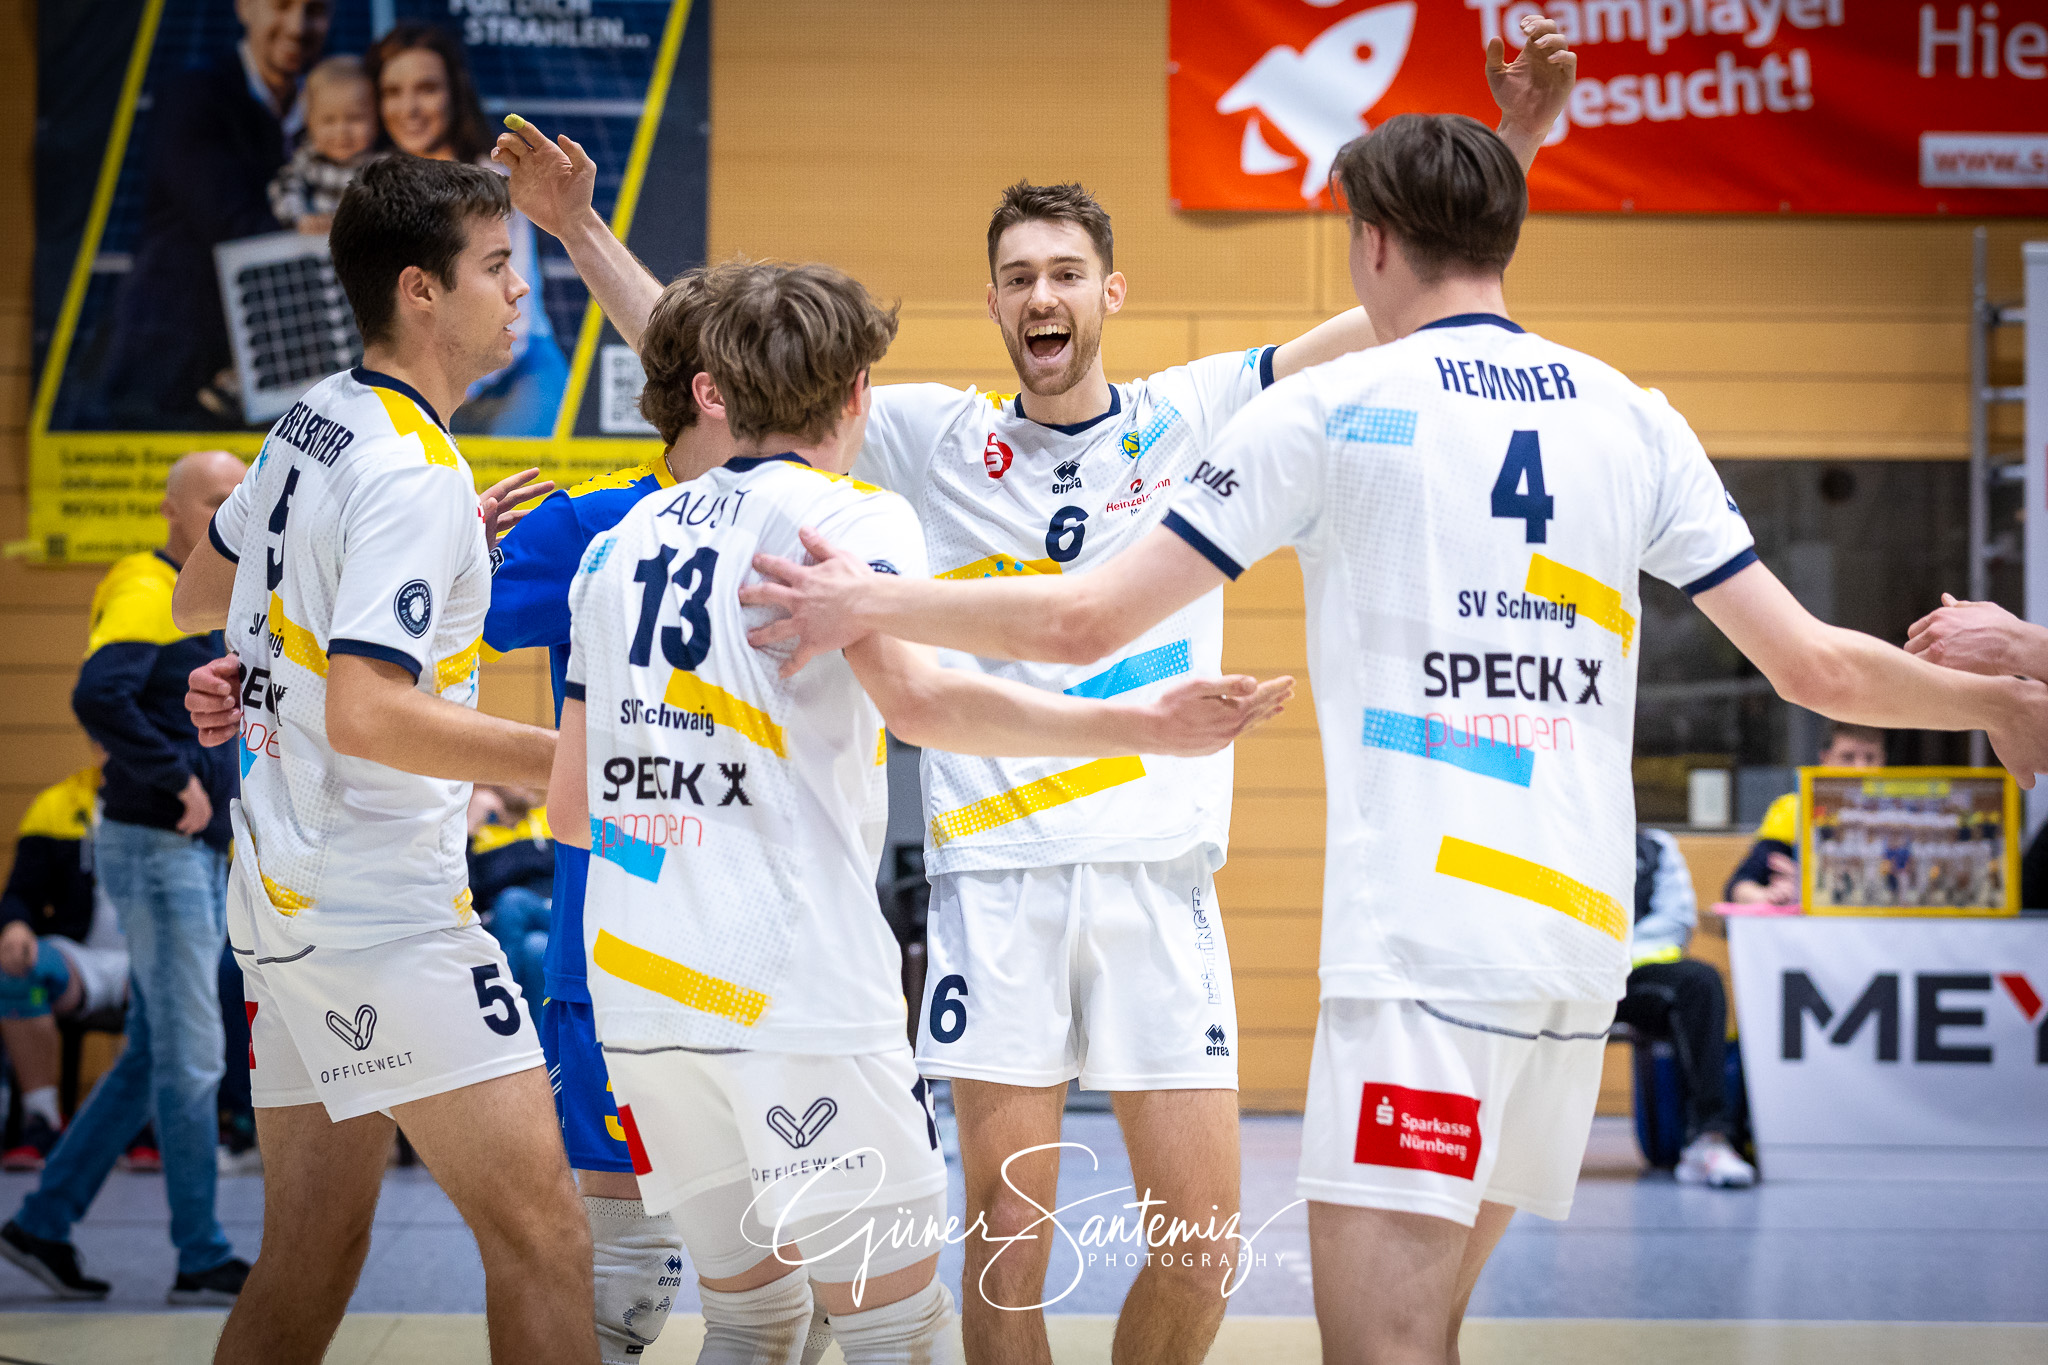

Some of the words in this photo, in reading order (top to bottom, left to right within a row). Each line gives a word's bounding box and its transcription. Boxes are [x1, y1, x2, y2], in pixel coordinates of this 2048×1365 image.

[1434, 356, 1578, 403] HEMMER
[1491, 430, 1554, 544] 4
[1045, 505, 1089, 562] 6
[629, 543, 720, 671] 13
[1459, 590, 1487, 618] SV
[1496, 591, 1577, 629] Schwaig
[1423, 651, 1568, 703] SPECK
[1425, 713, 1574, 759] pumpen
[470, 963, 521, 1036] 5
[929, 974, 968, 1044] 6
[320, 1051, 414, 1084] OFFICEWELT
[1400, 1112, 1472, 1138] Sparkasse
[1400, 1132, 1468, 1162] Nürnberg
[751, 1154, 867, 1183] OFFICEWELT
